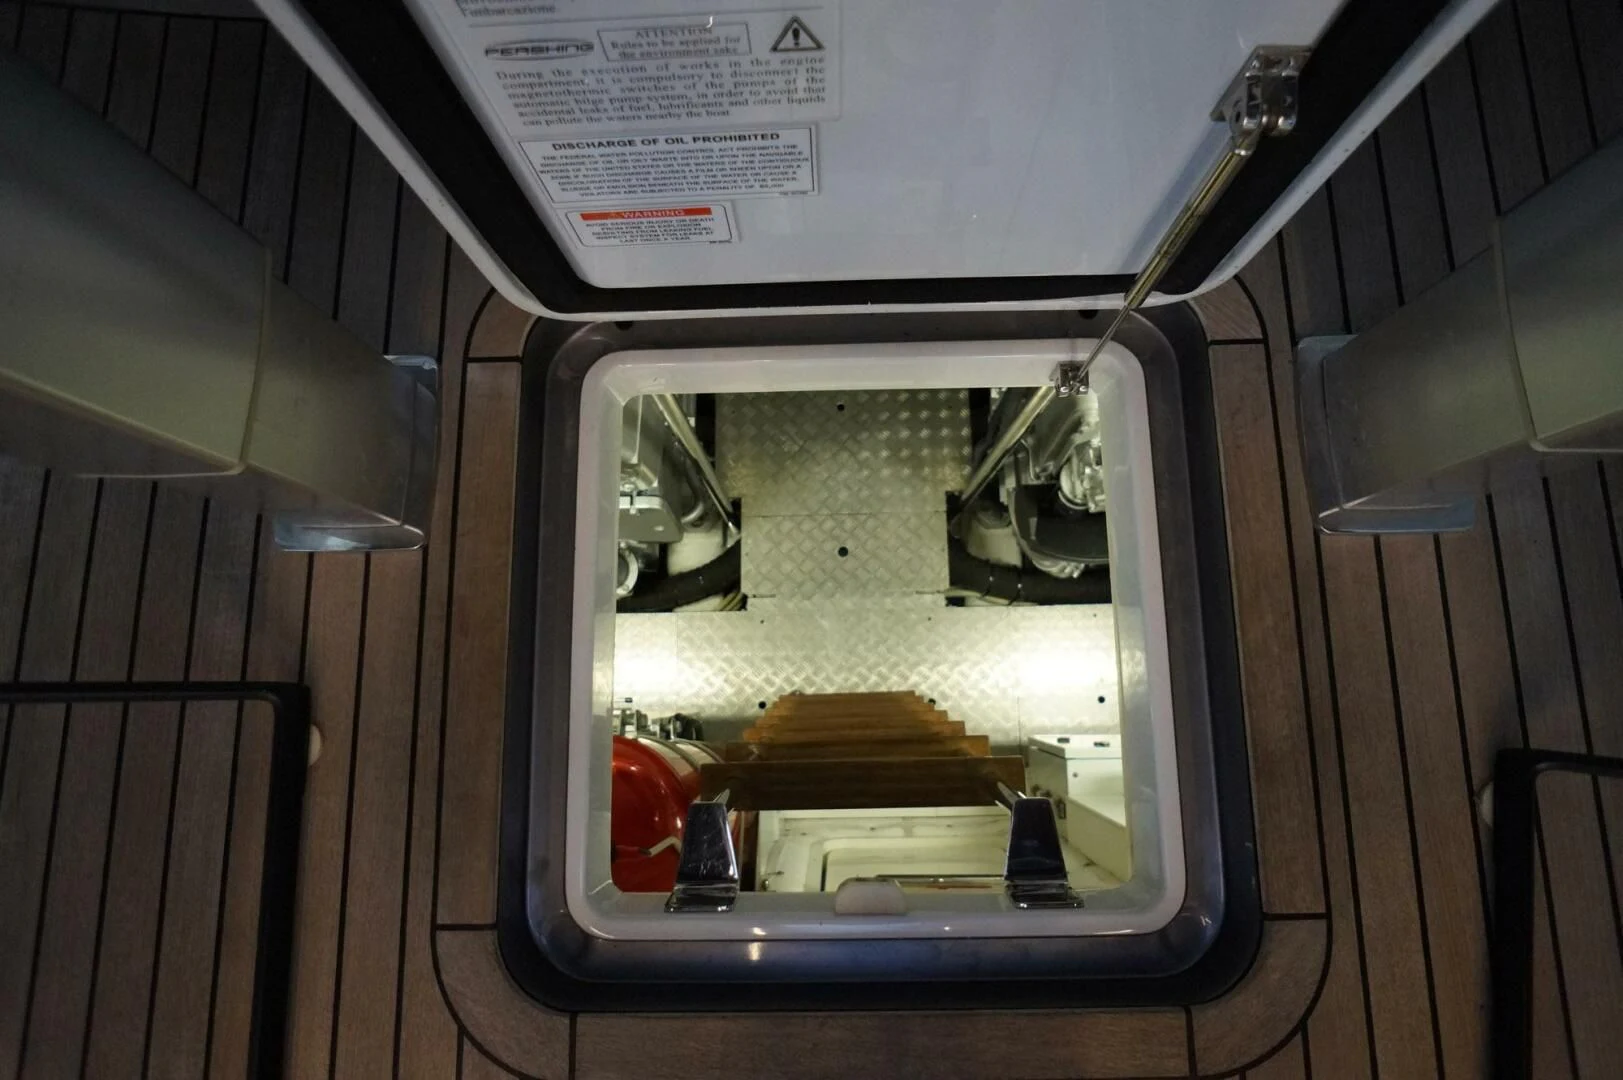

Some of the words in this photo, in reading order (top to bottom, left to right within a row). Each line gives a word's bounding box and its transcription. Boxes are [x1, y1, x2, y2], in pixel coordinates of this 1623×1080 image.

[637, 27, 712, 38] ATTENTION
[485, 43, 594, 57] PERSHING
[611, 41, 643, 49] Rules
[646, 40, 658, 48] to
[661, 39, 674, 47] be
[679, 36, 720, 47] applied
[724, 36, 740, 44] for
[496, 71, 544, 80] During
[551, 68, 572, 77] the
[581, 65, 647, 76] execution
[656, 63, 669, 72] of
[680, 61, 719, 70] works
[751, 57, 770, 67] the
[780, 56, 824, 67] engine
[595, 77, 604, 85] it
[630, 72, 703, 84] compulsory
[731, 68, 799, 78] disconnect
[806, 66, 824, 75] the
[507, 88, 611, 100] magnetothermic
[620, 84, 675, 94] switches
[683, 82, 696, 90] of
[705, 80, 724, 90] the
[734, 79, 776, 90] pumps
[784, 77, 797, 86] of
[806, 76, 825, 85] the
[512, 100, 570, 108] automatic
[575, 97, 604, 108] bilge
[608, 97, 641, 105] pump
[712, 89, 744, 98] order
[750, 89, 760, 97] to
[766, 87, 798, 96] avoid
[803, 86, 825, 95] that
[518, 107, 576, 117] accidental
[579, 105, 608, 114] leaks
[613, 104, 625, 113] of
[728, 97, 749, 107] and
[753, 97, 781, 105] other
[787, 95, 826, 106] liquids
[544, 116, 582, 127] pollute
[586, 115, 602, 123] the
[606, 114, 642, 122] waters
[645, 111, 682, 121] nearby
[685, 110, 702, 118] the
[552, 140, 637, 151] DISCHARGE
[641, 138, 660, 146] OF
[665, 137, 689, 145] OIL
[692, 133, 780, 144] PROHIBITED
[623, 209, 685, 219] WARNING
